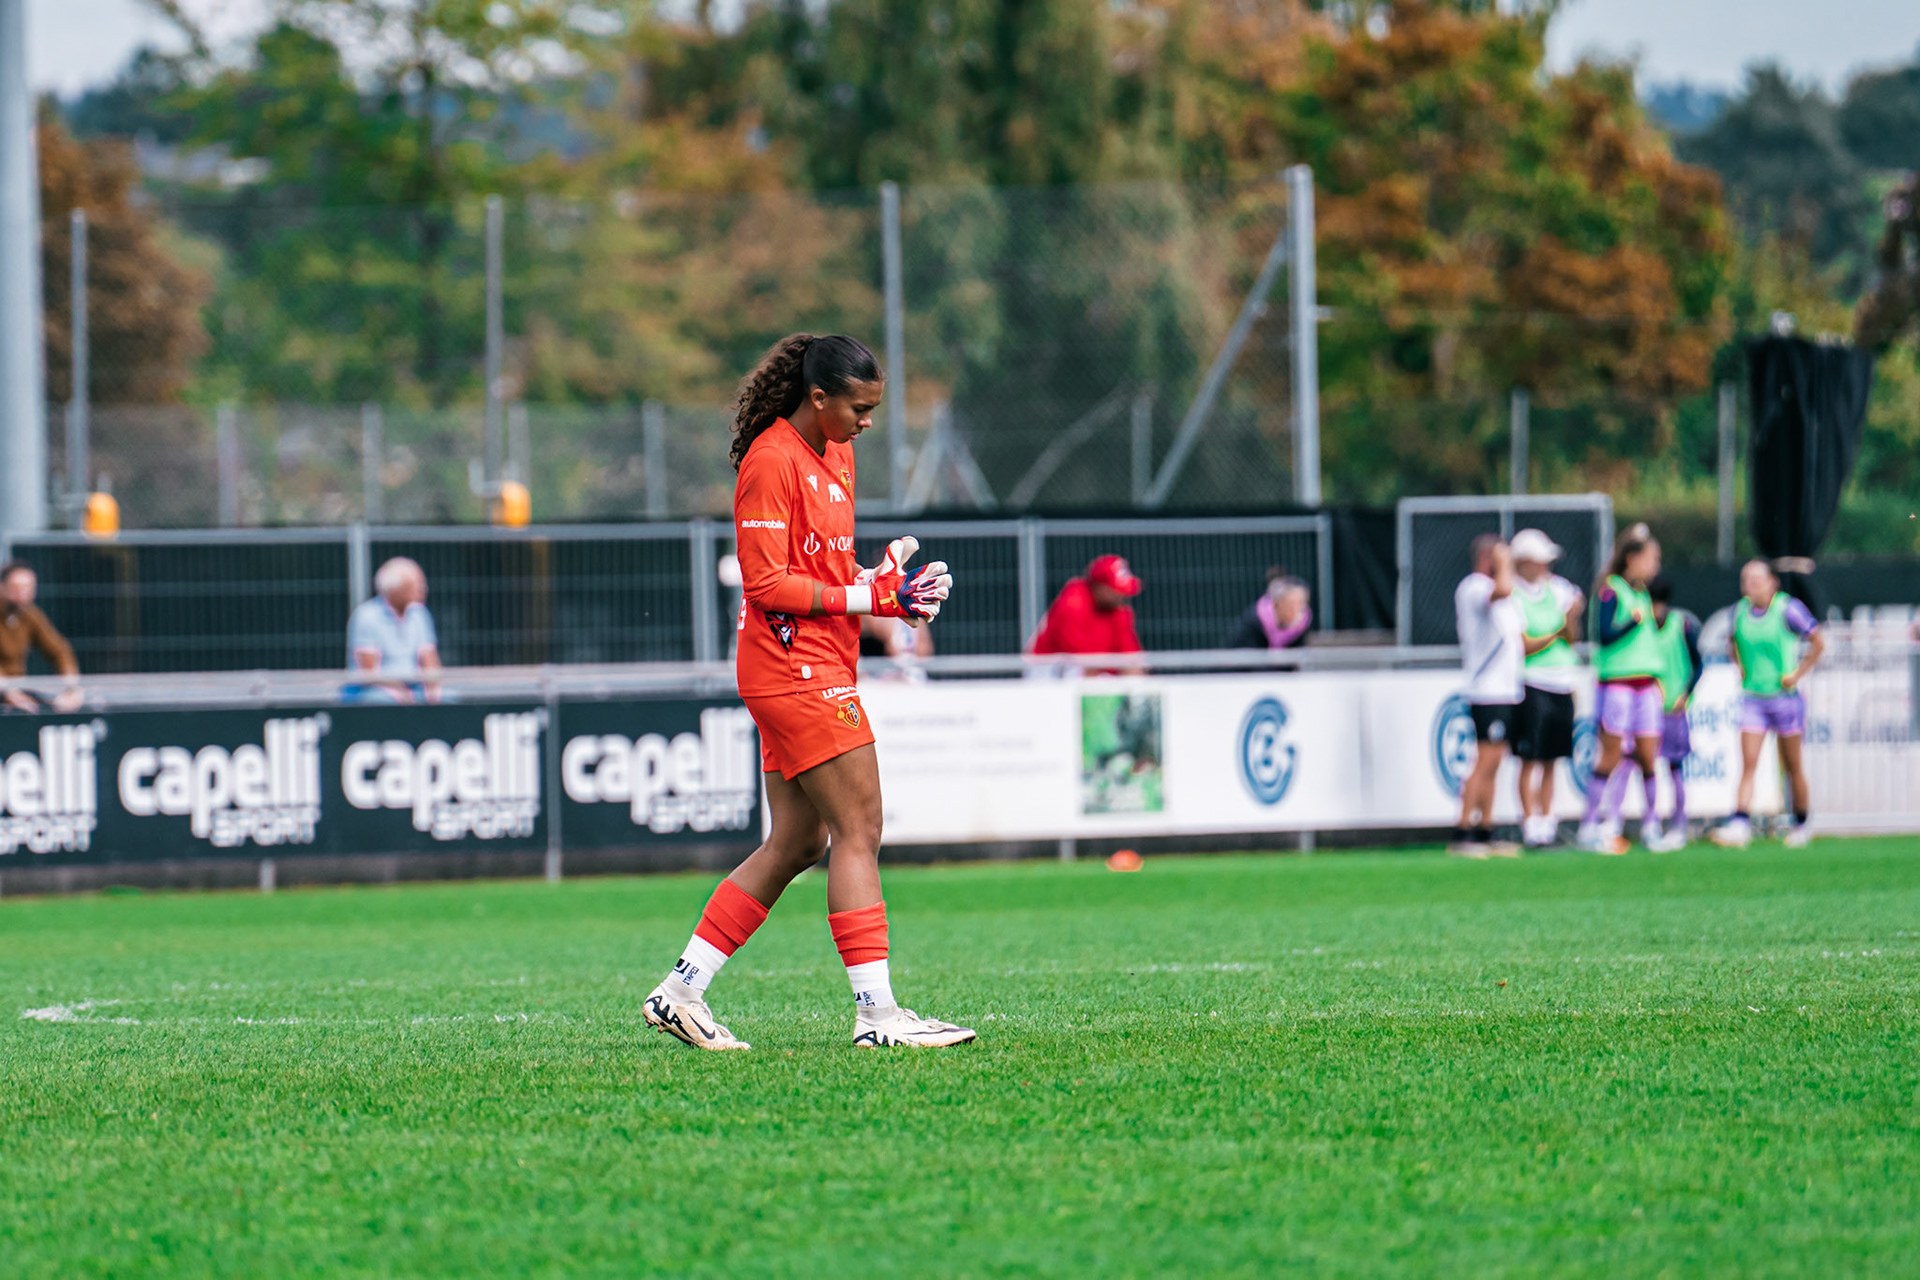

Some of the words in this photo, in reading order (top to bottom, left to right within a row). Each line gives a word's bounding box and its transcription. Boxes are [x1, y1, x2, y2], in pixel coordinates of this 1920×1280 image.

[741, 519, 786, 530] automobile
[0, 723, 99, 818] elli
[117, 717, 322, 838] capelli
[341, 712, 542, 832] capelli
[561, 706, 756, 826] capelli
[210, 807, 322, 847] SPORT
[430, 799, 541, 841] SPORT
[648, 793, 756, 834] SPORT
